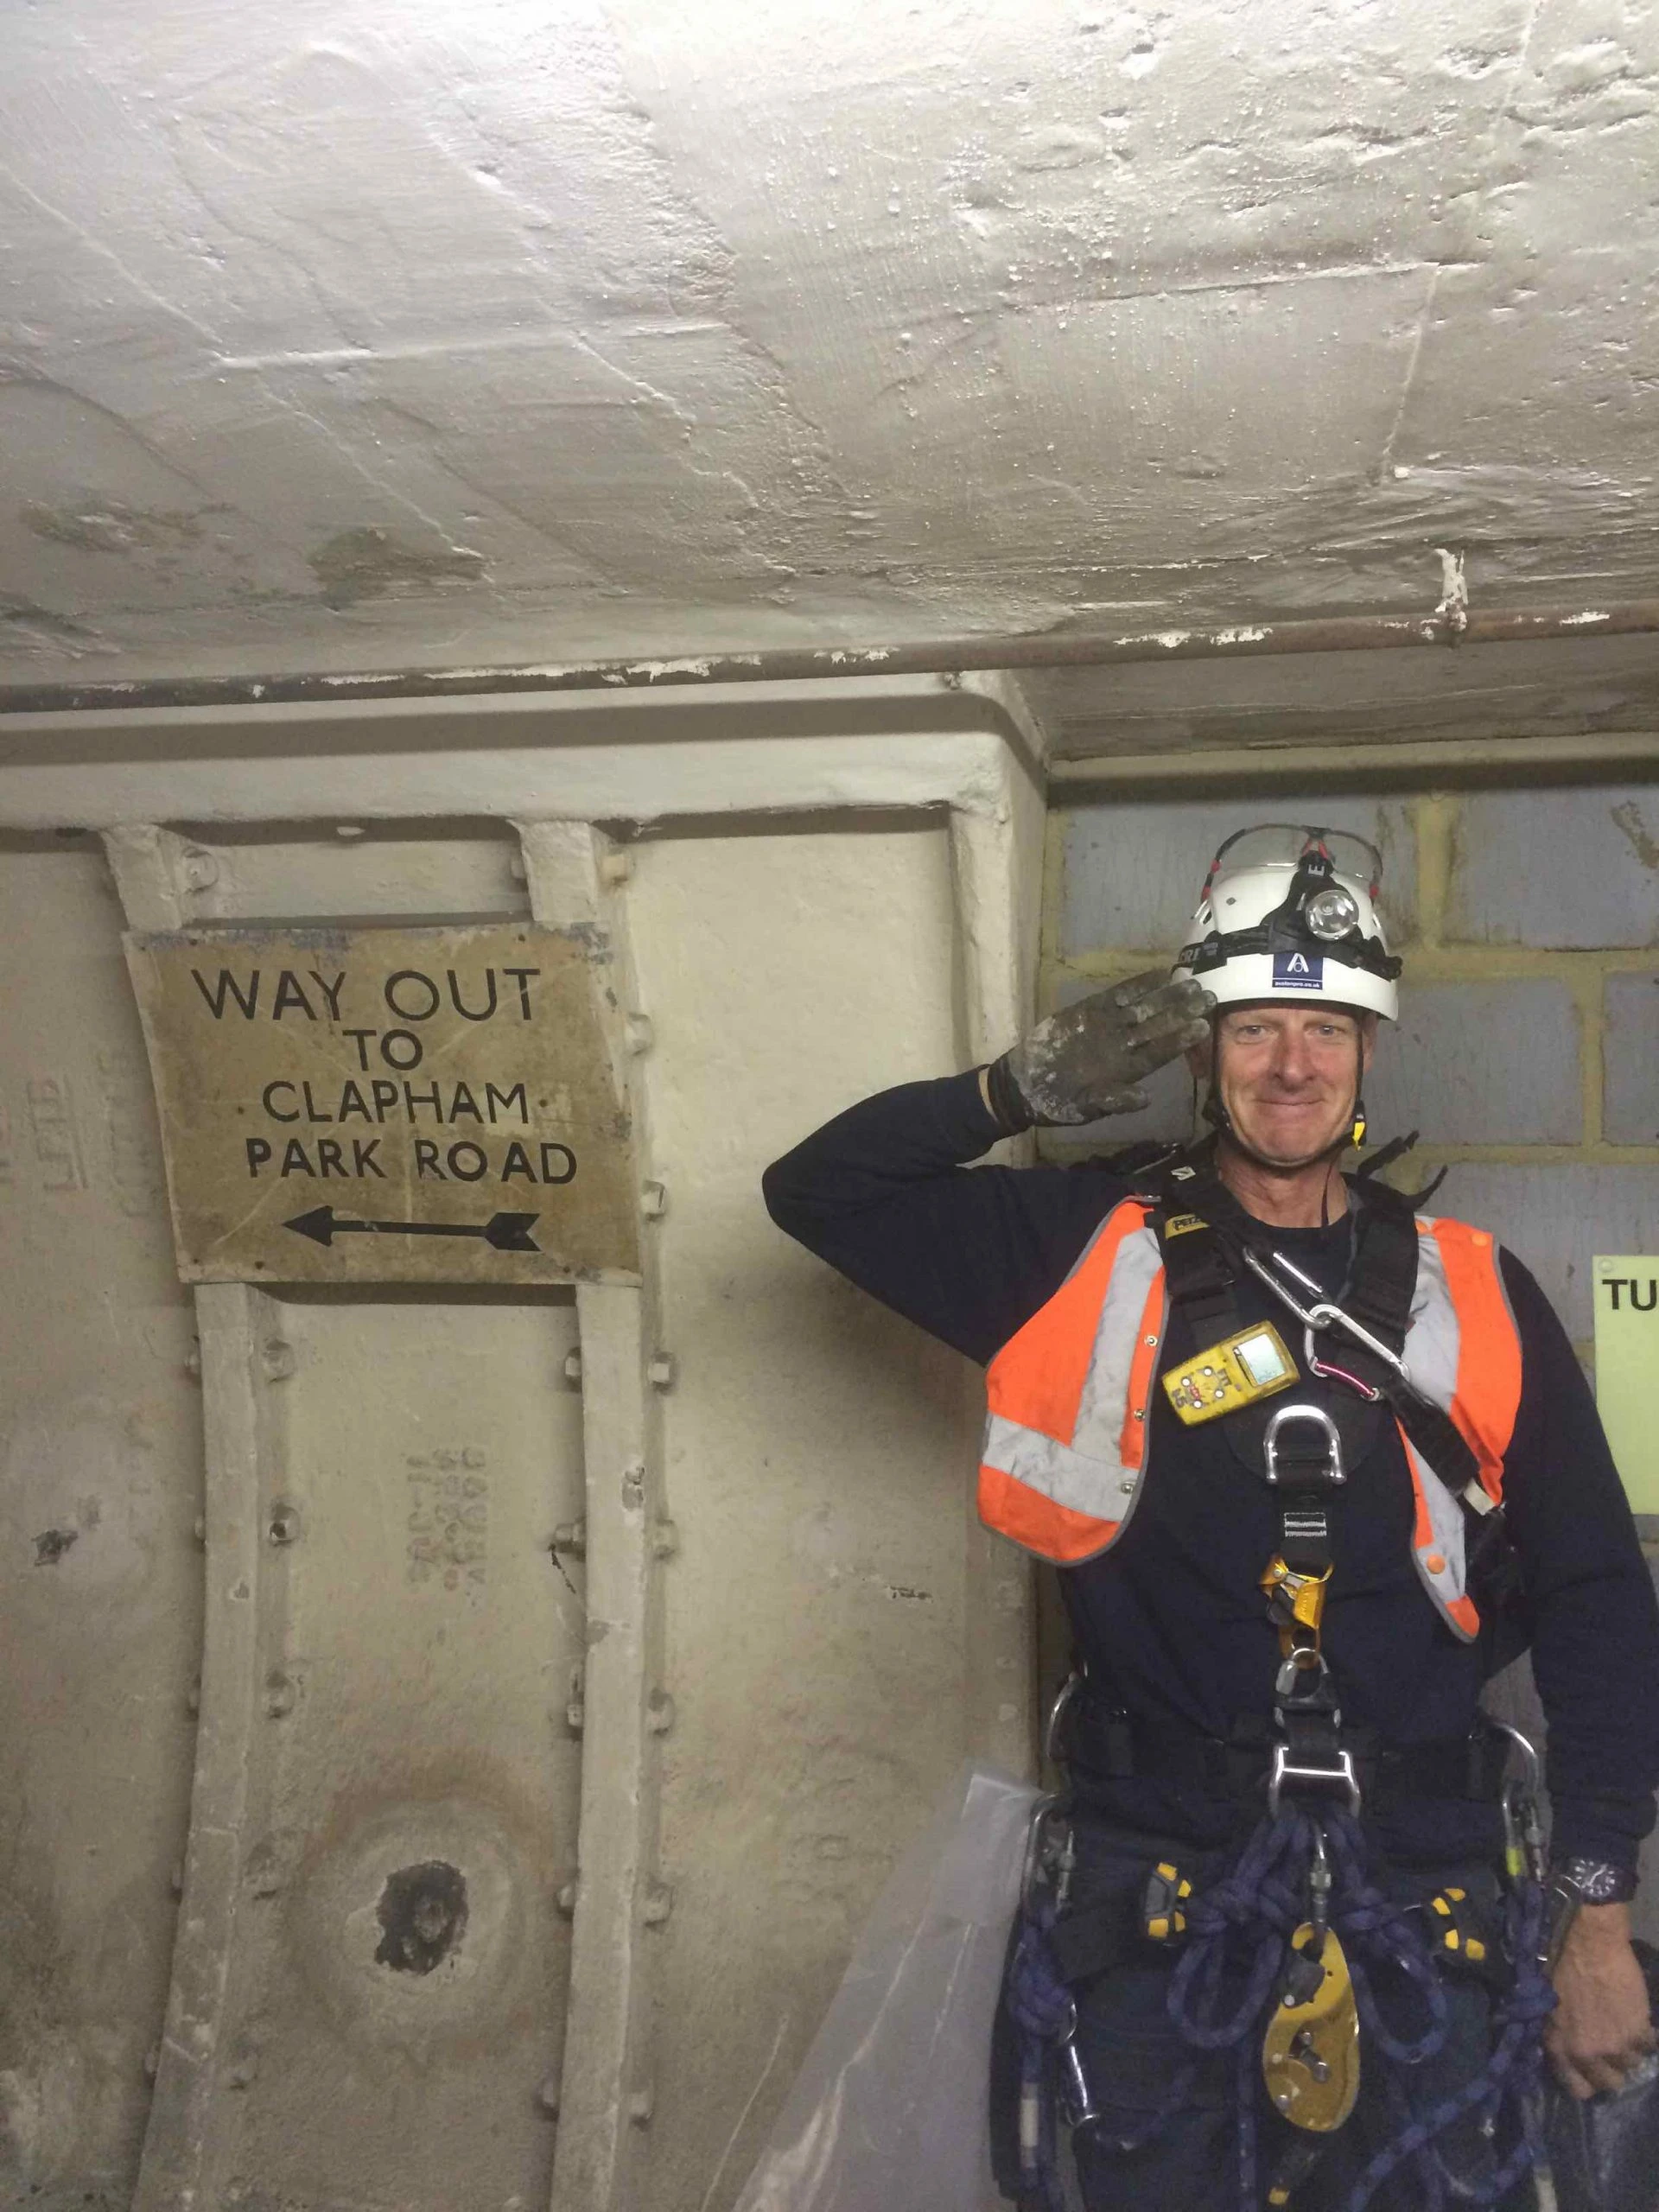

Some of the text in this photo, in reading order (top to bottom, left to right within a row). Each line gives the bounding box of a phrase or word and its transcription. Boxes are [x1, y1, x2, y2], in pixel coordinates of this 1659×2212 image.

[190, 969, 541, 1021] WAY OUT
[342, 1028, 423, 1071] TO
[262, 1079, 530, 1124] CLAPHAM
[245, 1137, 577, 1185] PARK ROAD
[1601, 1279, 1657, 1312] TU
